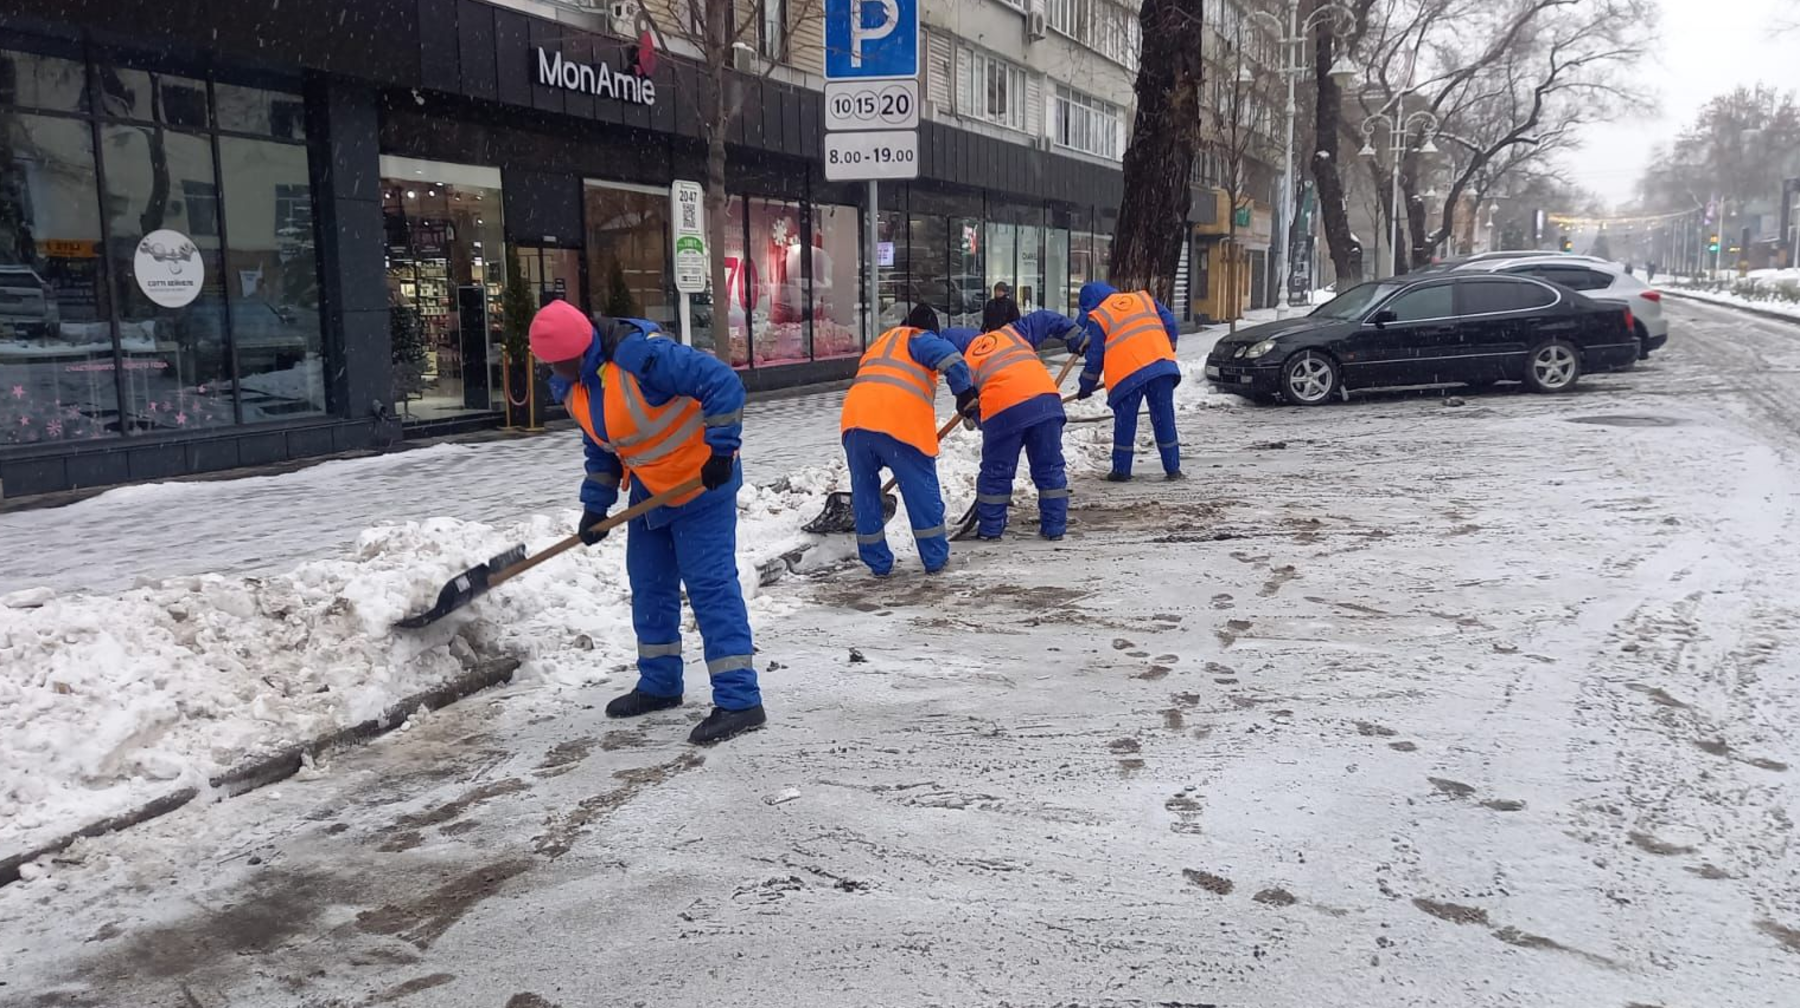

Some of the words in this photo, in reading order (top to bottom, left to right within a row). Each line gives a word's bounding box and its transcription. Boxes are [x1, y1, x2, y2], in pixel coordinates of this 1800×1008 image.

[538, 46, 656, 106] MonAmie
[834, 98, 852, 115] 10
[856, 97, 875, 114] 15
[881, 94, 909, 115] 20
